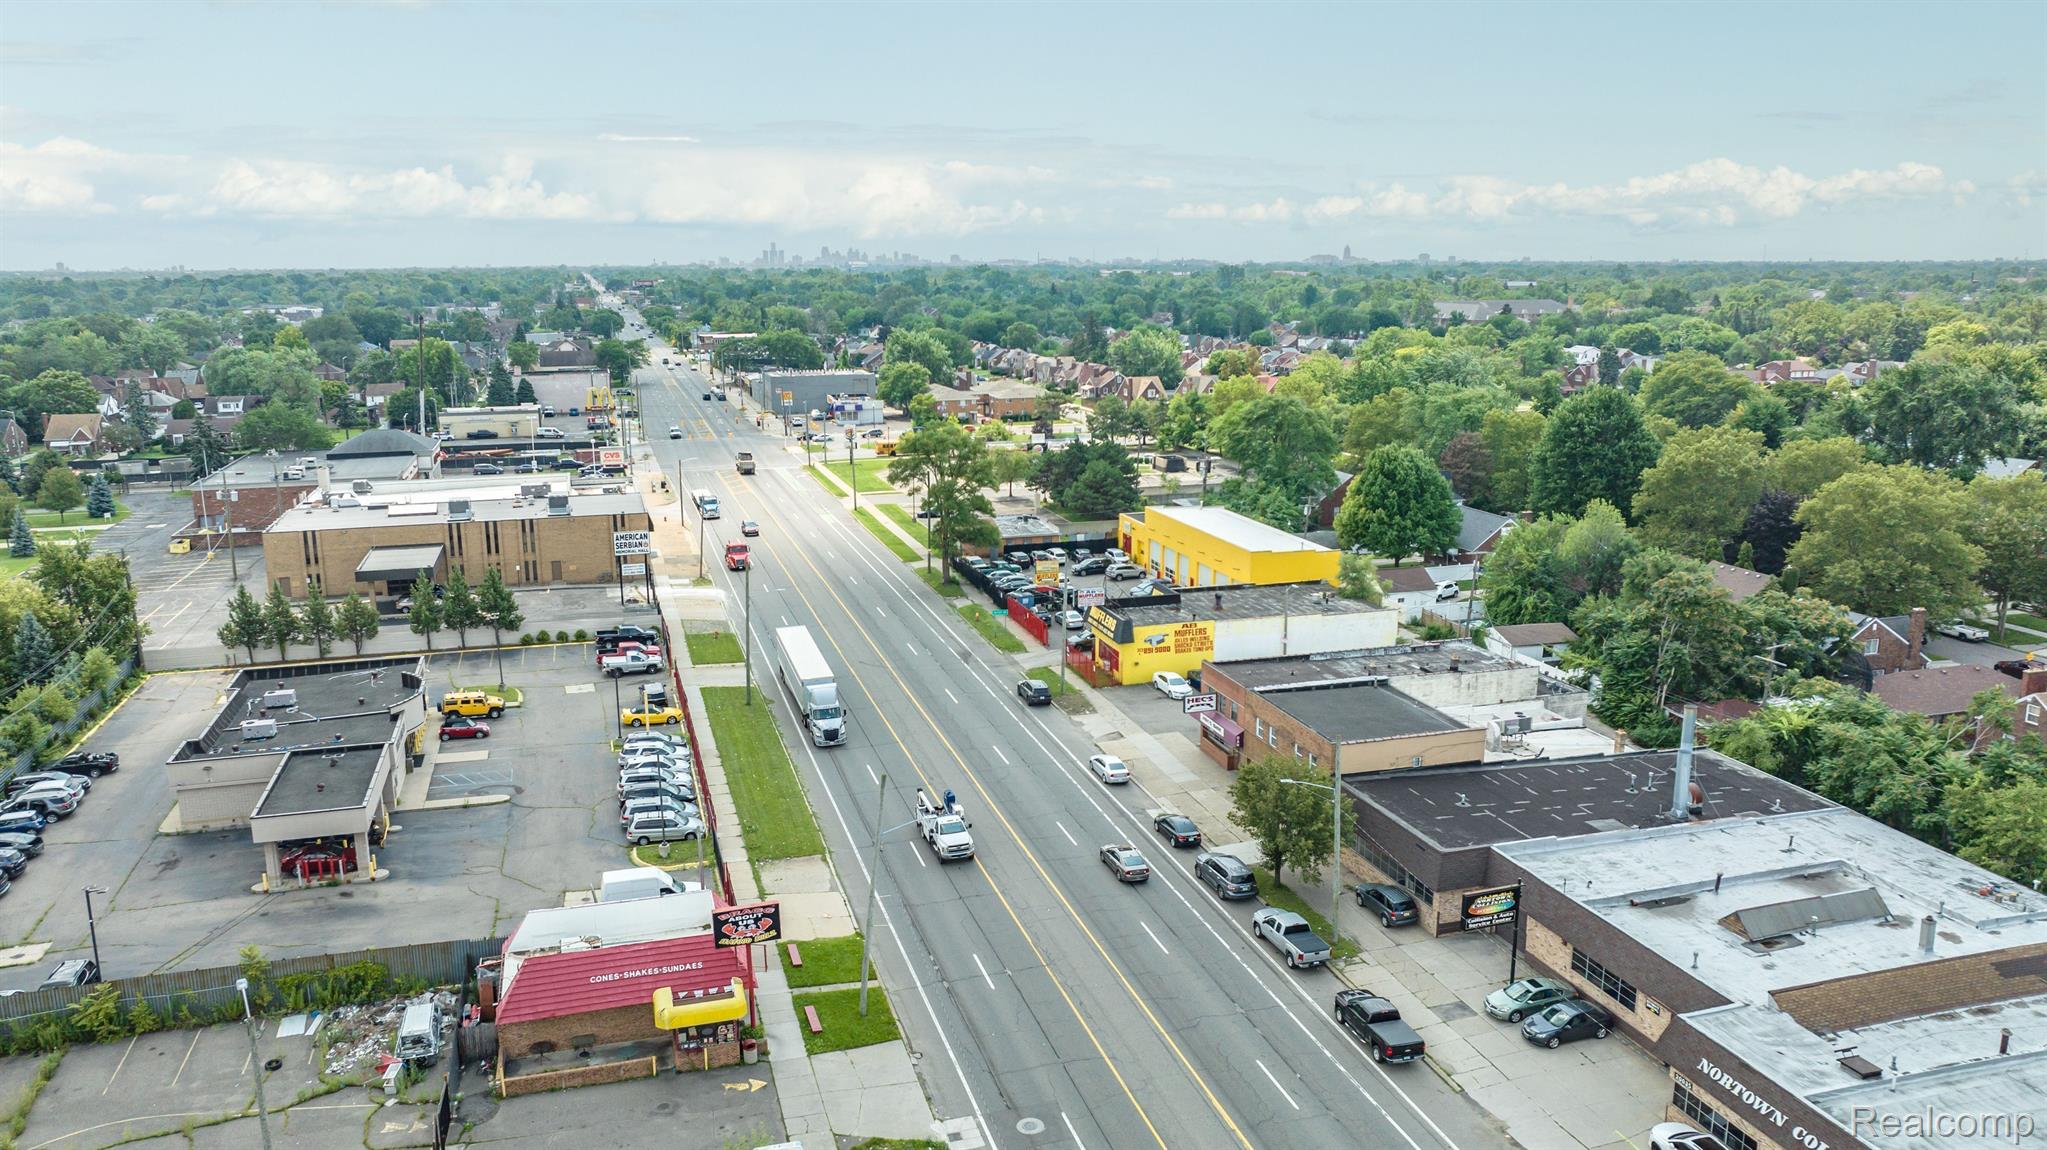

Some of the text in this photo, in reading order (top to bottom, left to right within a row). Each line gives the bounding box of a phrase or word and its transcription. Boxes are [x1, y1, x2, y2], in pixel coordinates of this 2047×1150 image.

[615, 532, 648, 541] AMERICAN
[615, 541, 643, 549] SERBIAN
[1174, 628, 1207, 637] MUFFLERS
[728, 912, 763, 923] ABOUT
[589, 961, 703, 983] CONES SHAKES SUNDAES
[1696, 1057, 1789, 1127] NORTOWN
